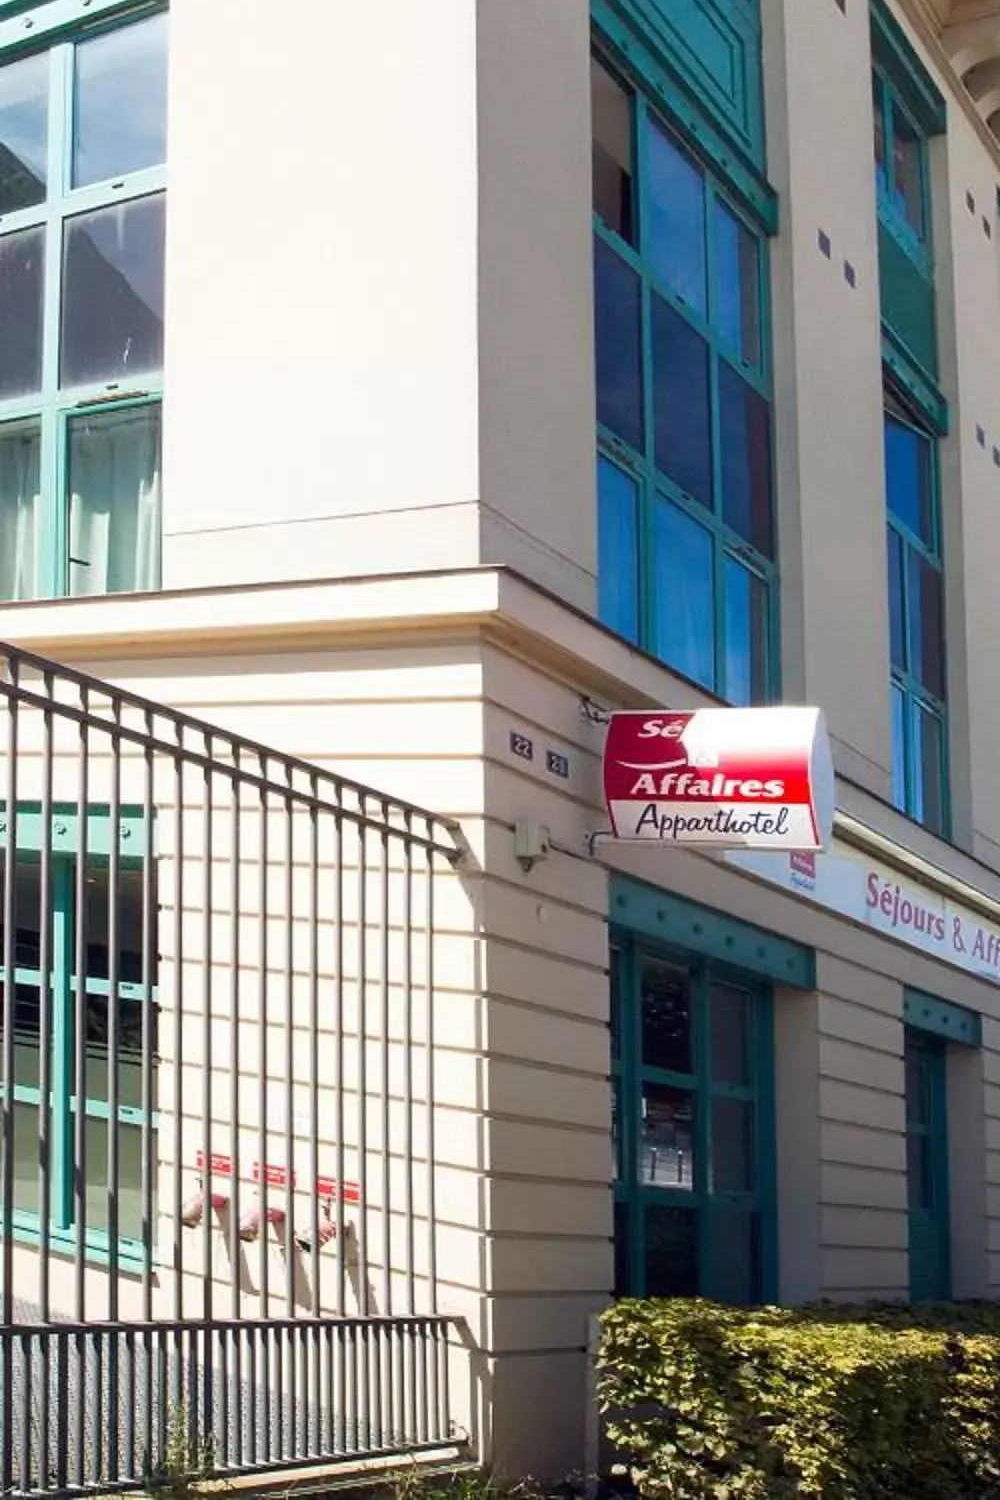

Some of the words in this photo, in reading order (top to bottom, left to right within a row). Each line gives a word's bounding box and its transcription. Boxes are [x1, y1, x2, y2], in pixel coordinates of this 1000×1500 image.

[637, 719, 685, 742] Sé
[514, 735, 530, 757] 22
[629, 772, 785, 798] Affaires
[635, 803, 789, 840] Apparthotel
[866, 871, 946, 942] Séjours
[953, 914, 967, 955] &
